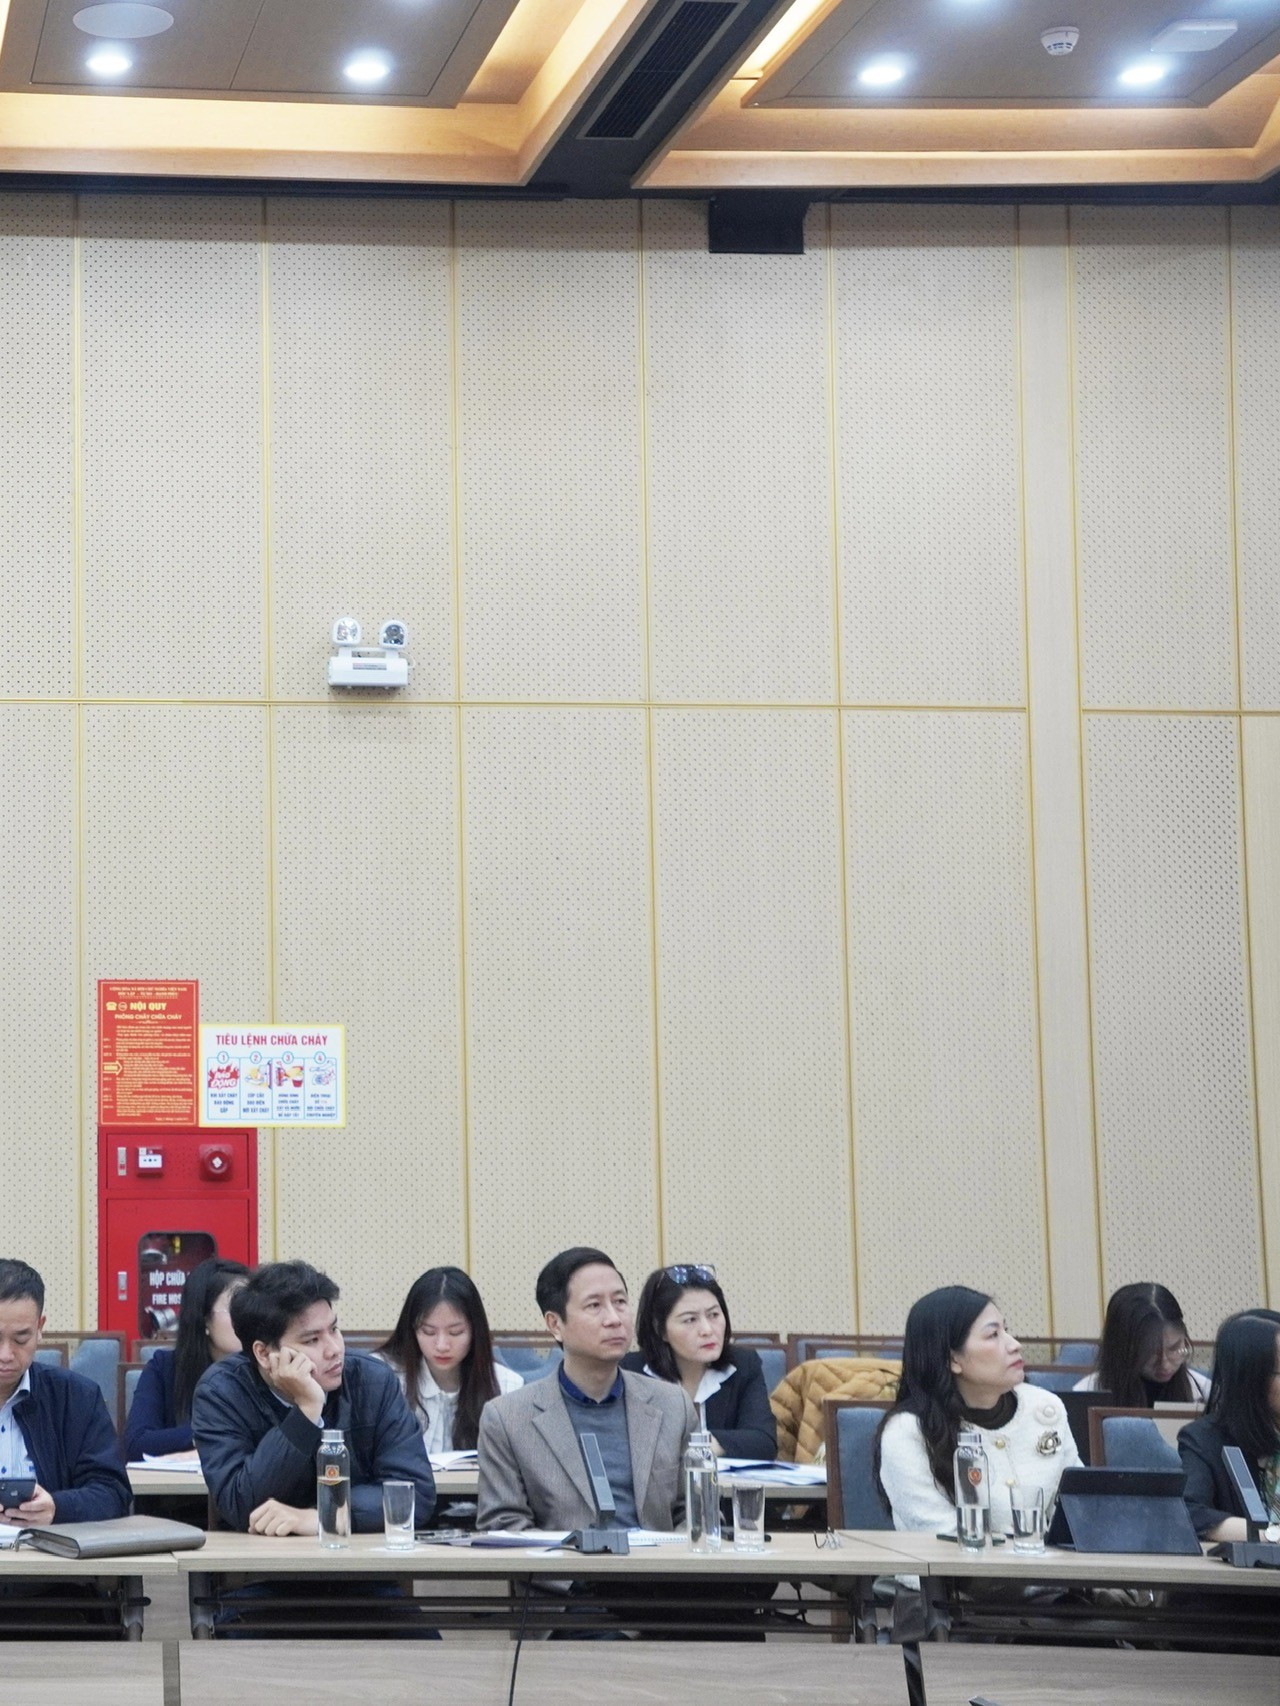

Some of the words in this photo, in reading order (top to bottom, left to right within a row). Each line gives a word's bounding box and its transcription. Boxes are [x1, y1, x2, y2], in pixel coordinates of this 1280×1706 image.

[130, 1001, 146, 1011] NỘI
[148, 1002, 167, 1011] QUY
[216, 1033, 238, 1045] TIÊU
[241, 1033, 267, 1048] LỆNH
[270, 1032, 298, 1046] CHỮA
[301, 1033, 328, 1046] CHÁY
[149, 1269, 164, 1288] HỘP
[152, 1293, 167, 1305] FIRE
[168, 1293, 182, 1305] HOS
